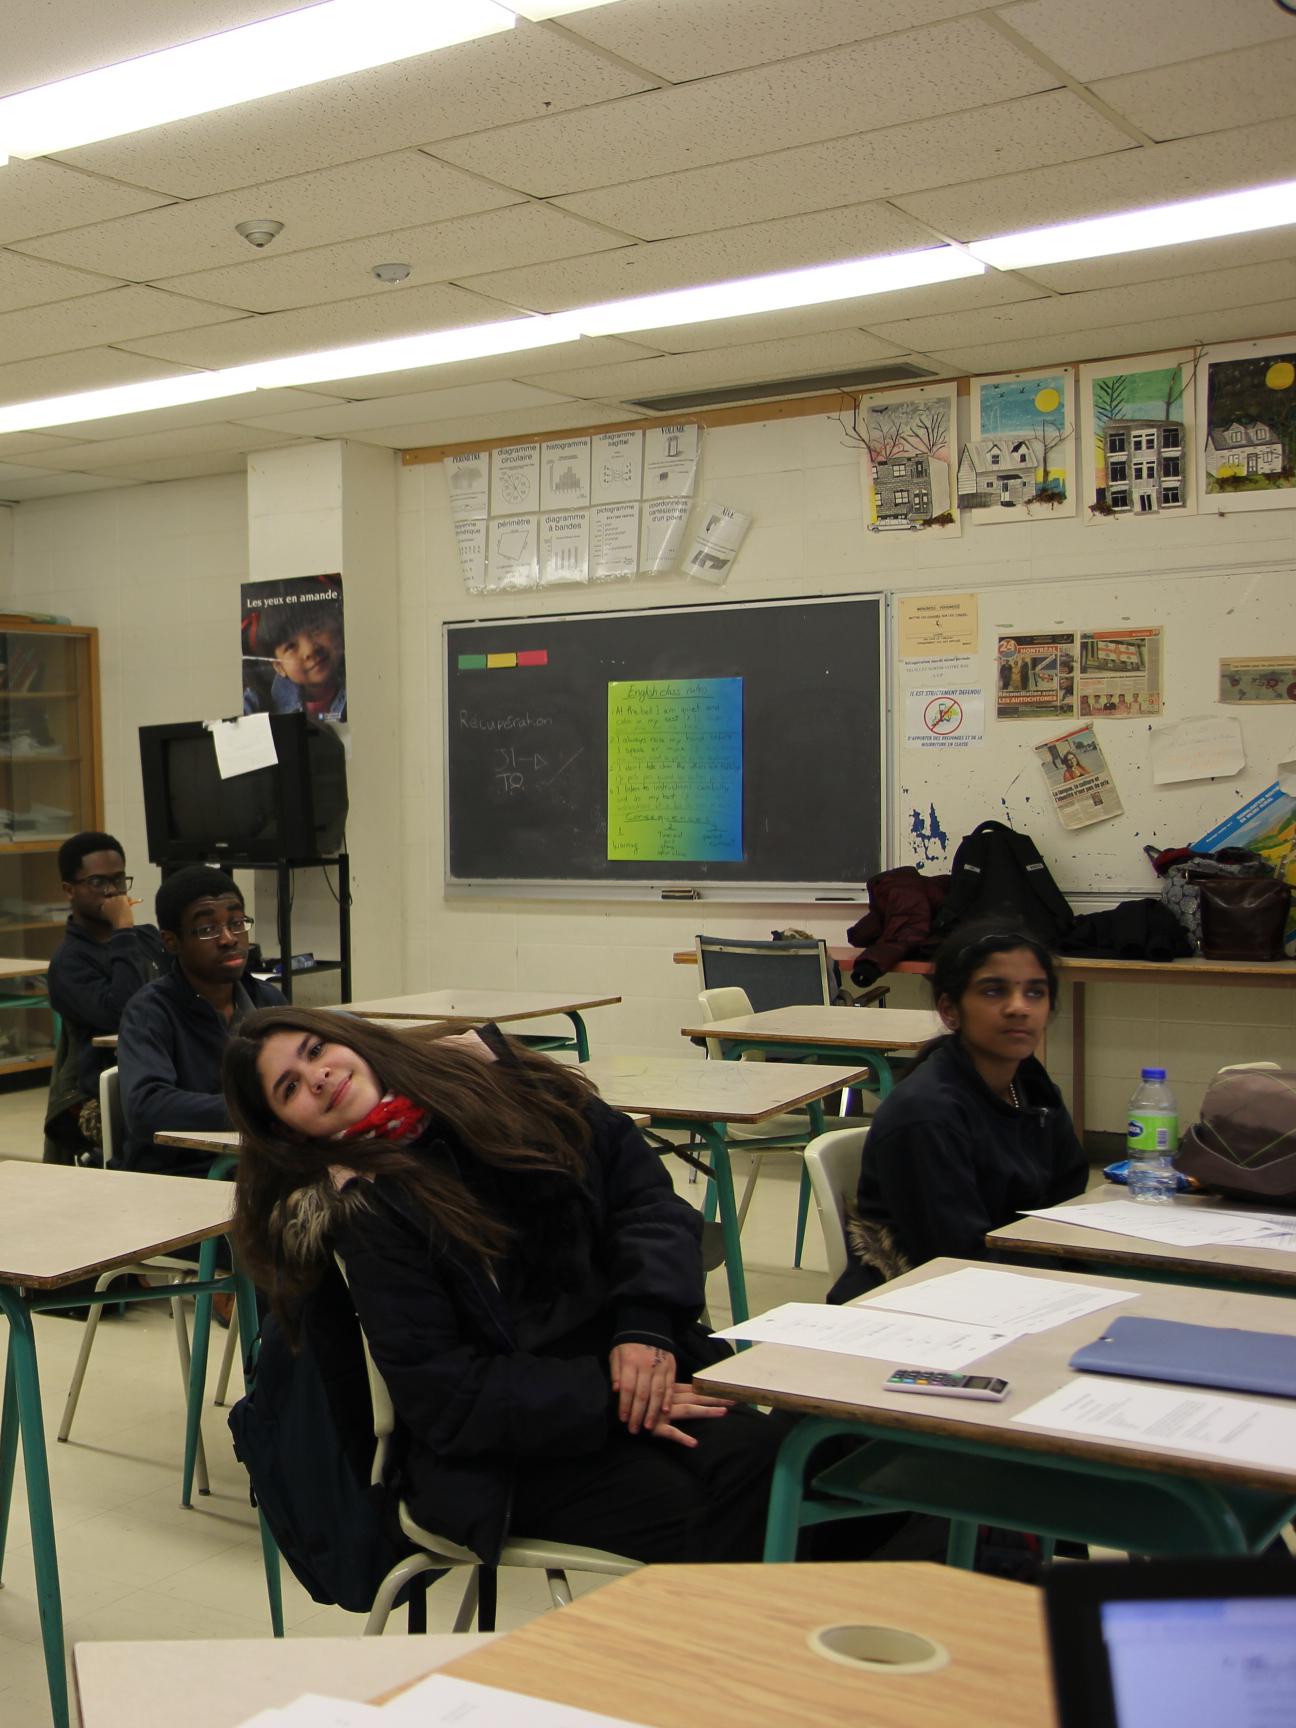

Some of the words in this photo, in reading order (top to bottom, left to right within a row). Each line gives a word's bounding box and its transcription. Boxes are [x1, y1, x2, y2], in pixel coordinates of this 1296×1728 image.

[602, 431, 635, 442] diagramme
[497, 445, 537, 456] diagramme
[546, 440, 588, 451] histogramme
[501, 454, 533, 465] circulaire
[596, 504, 635, 516] pictogramme
[497, 518, 531, 529] périmètre
[545, 513, 586, 525] diagramme
[652, 515, 665, 523] d'un
[554, 523, 582, 532] bandes
[247, 597, 262, 608] Les
[264, 597, 284, 609] yeux
[286, 594, 297, 604] en
[299, 589, 338, 603] amande
[999, 640, 1015, 652] 24
[627, 684, 658, 703] English
[925, 689, 958, 697] STRICTEMENT
[999, 690, 1042, 698] Réconciliation
[1011, 695, 1057, 703] AUTOCHTONES
